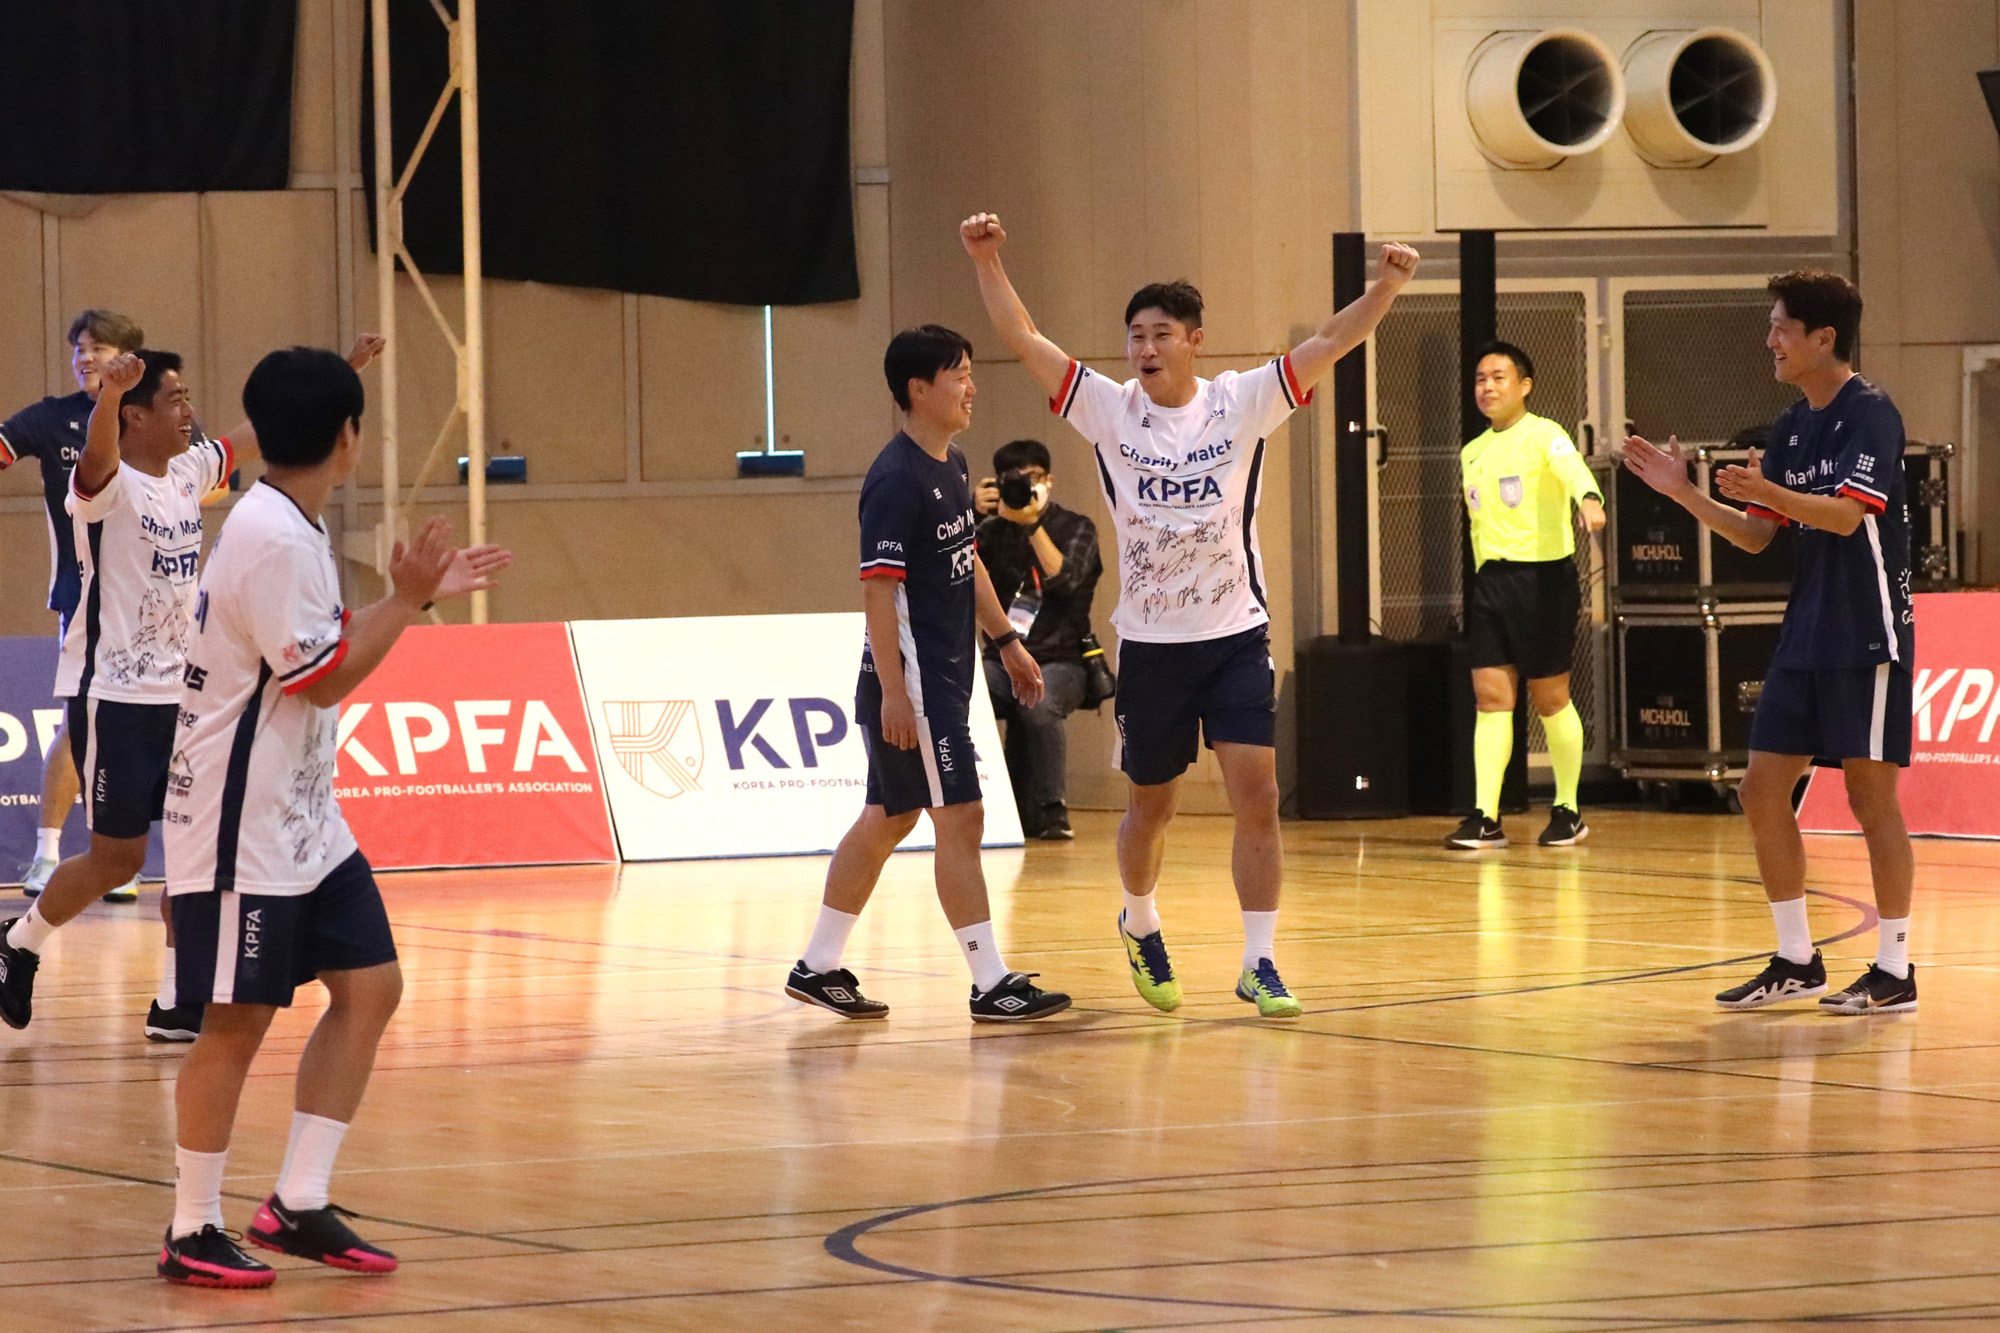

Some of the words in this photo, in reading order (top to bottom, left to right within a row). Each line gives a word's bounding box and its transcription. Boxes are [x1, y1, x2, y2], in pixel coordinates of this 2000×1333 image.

[1119, 444, 1178, 471] Charity
[1138, 475, 1223, 503] KPFA
[877, 541, 904, 553] KPFA
[1640, 708, 1691, 726] MICHUHOLL
[333, 700, 588, 778] KPFA
[715, 697, 848, 770] KP
[938, 736, 954, 772] KPFA
[96, 768, 107, 802] KPFA
[334, 788, 370, 799] OREA
[374, 783, 504, 797] PRO-FOOTBALLER'S
[508, 782, 592, 793] ASSOCIATION
[733, 781, 775, 790] KOREA
[780, 778, 867, 788] PRO-FOOTBAL
[244, 908, 262, 958] KPFA
